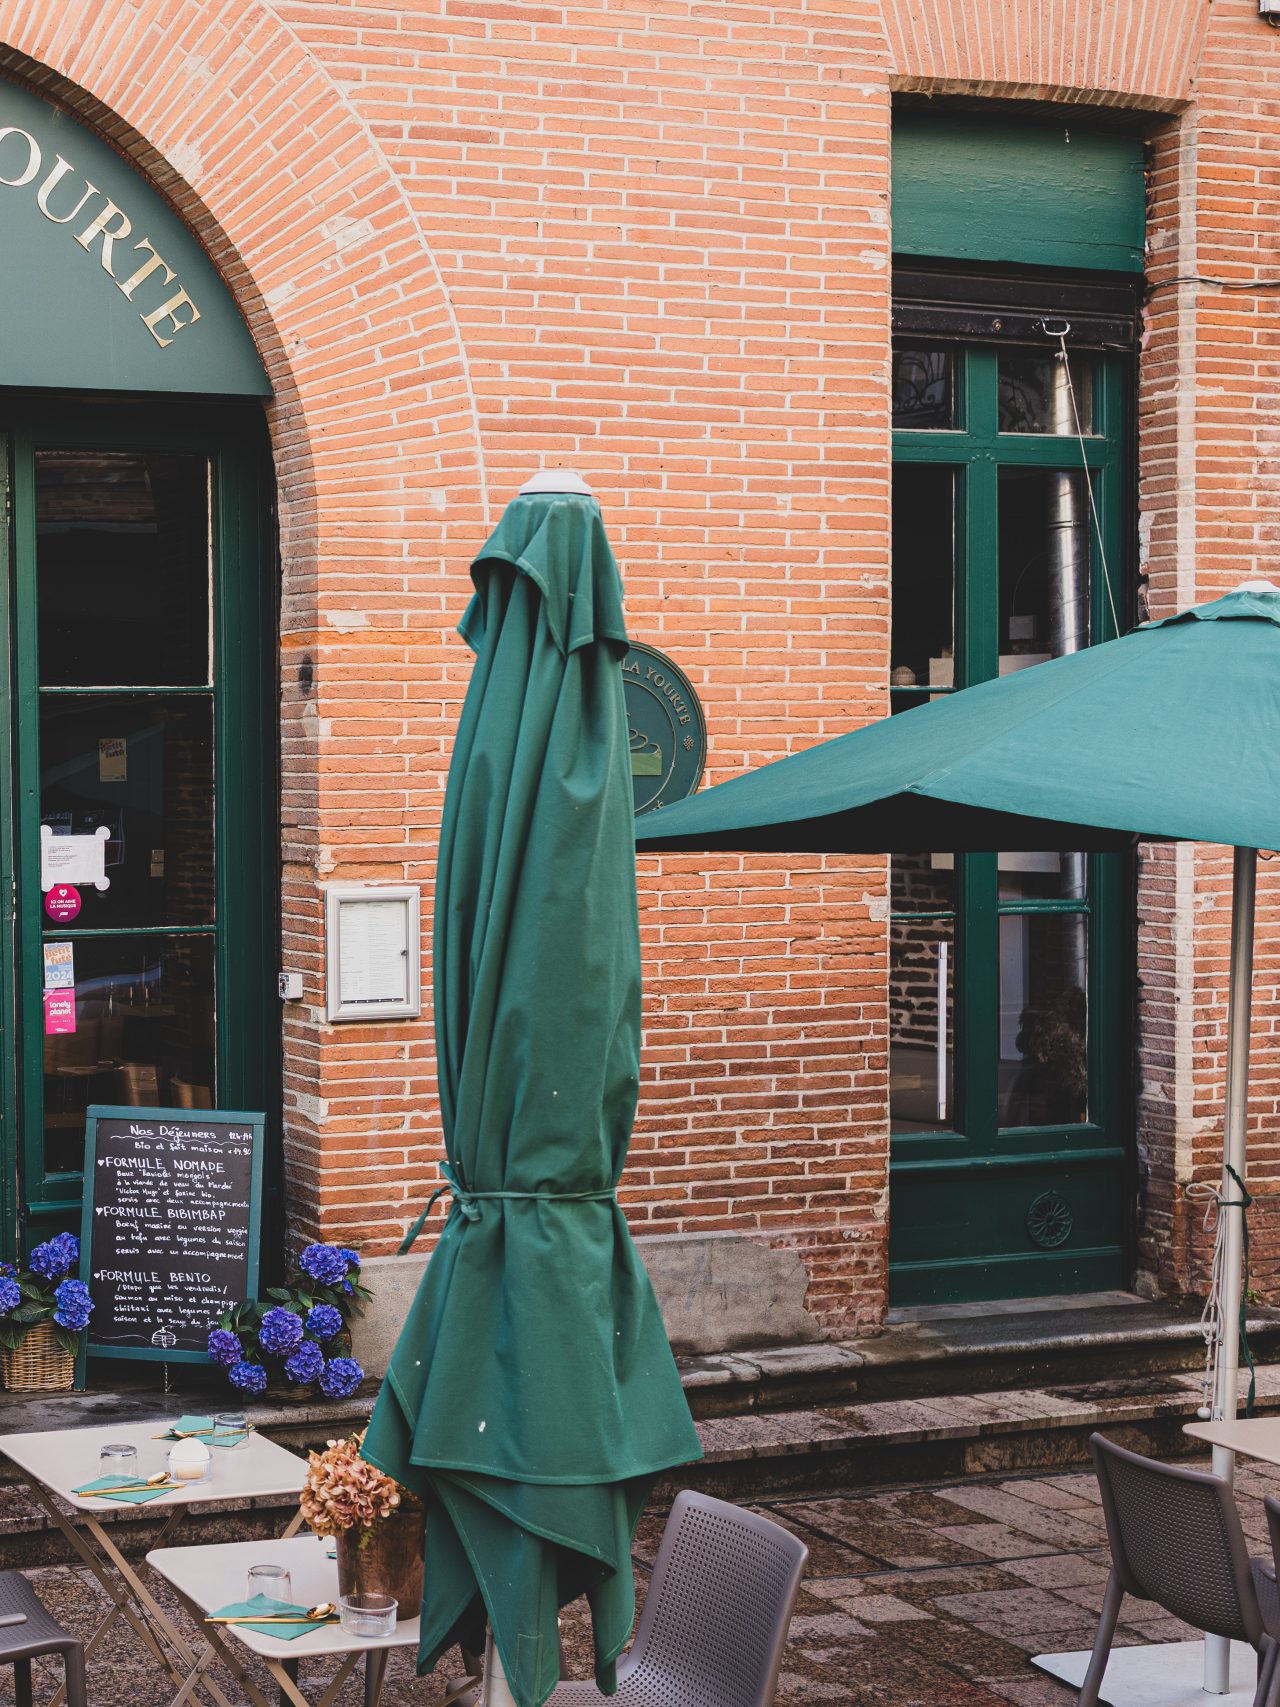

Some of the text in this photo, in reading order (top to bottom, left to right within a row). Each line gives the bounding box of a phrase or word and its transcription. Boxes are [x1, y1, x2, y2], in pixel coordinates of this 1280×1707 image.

[645, 666, 691, 726] YOURTE
[50, 1001, 71, 1009] lonely
[50, 1008, 71, 1016] planet
[129, 1125, 154, 1136] Nos
[134, 1141, 151, 1150] Bio
[156, 1143, 165, 1151] et
[170, 1143, 186, 1151] fait
[191, 1145, 223, 1154] maison
[105, 1157, 225, 1173] FORMULE NOMADE
[159, 1179, 168, 1187] de
[103, 1206, 226, 1220] FORMULE BIBIMBAP
[131, 1232, 148, 1243] tofu
[225, 1239, 246, 1247] saison
[182, 1249, 244, 1260] accompagnement
[100, 1270, 211, 1284] FORMULE BENTO
[113, 1315, 138, 1323] saison
